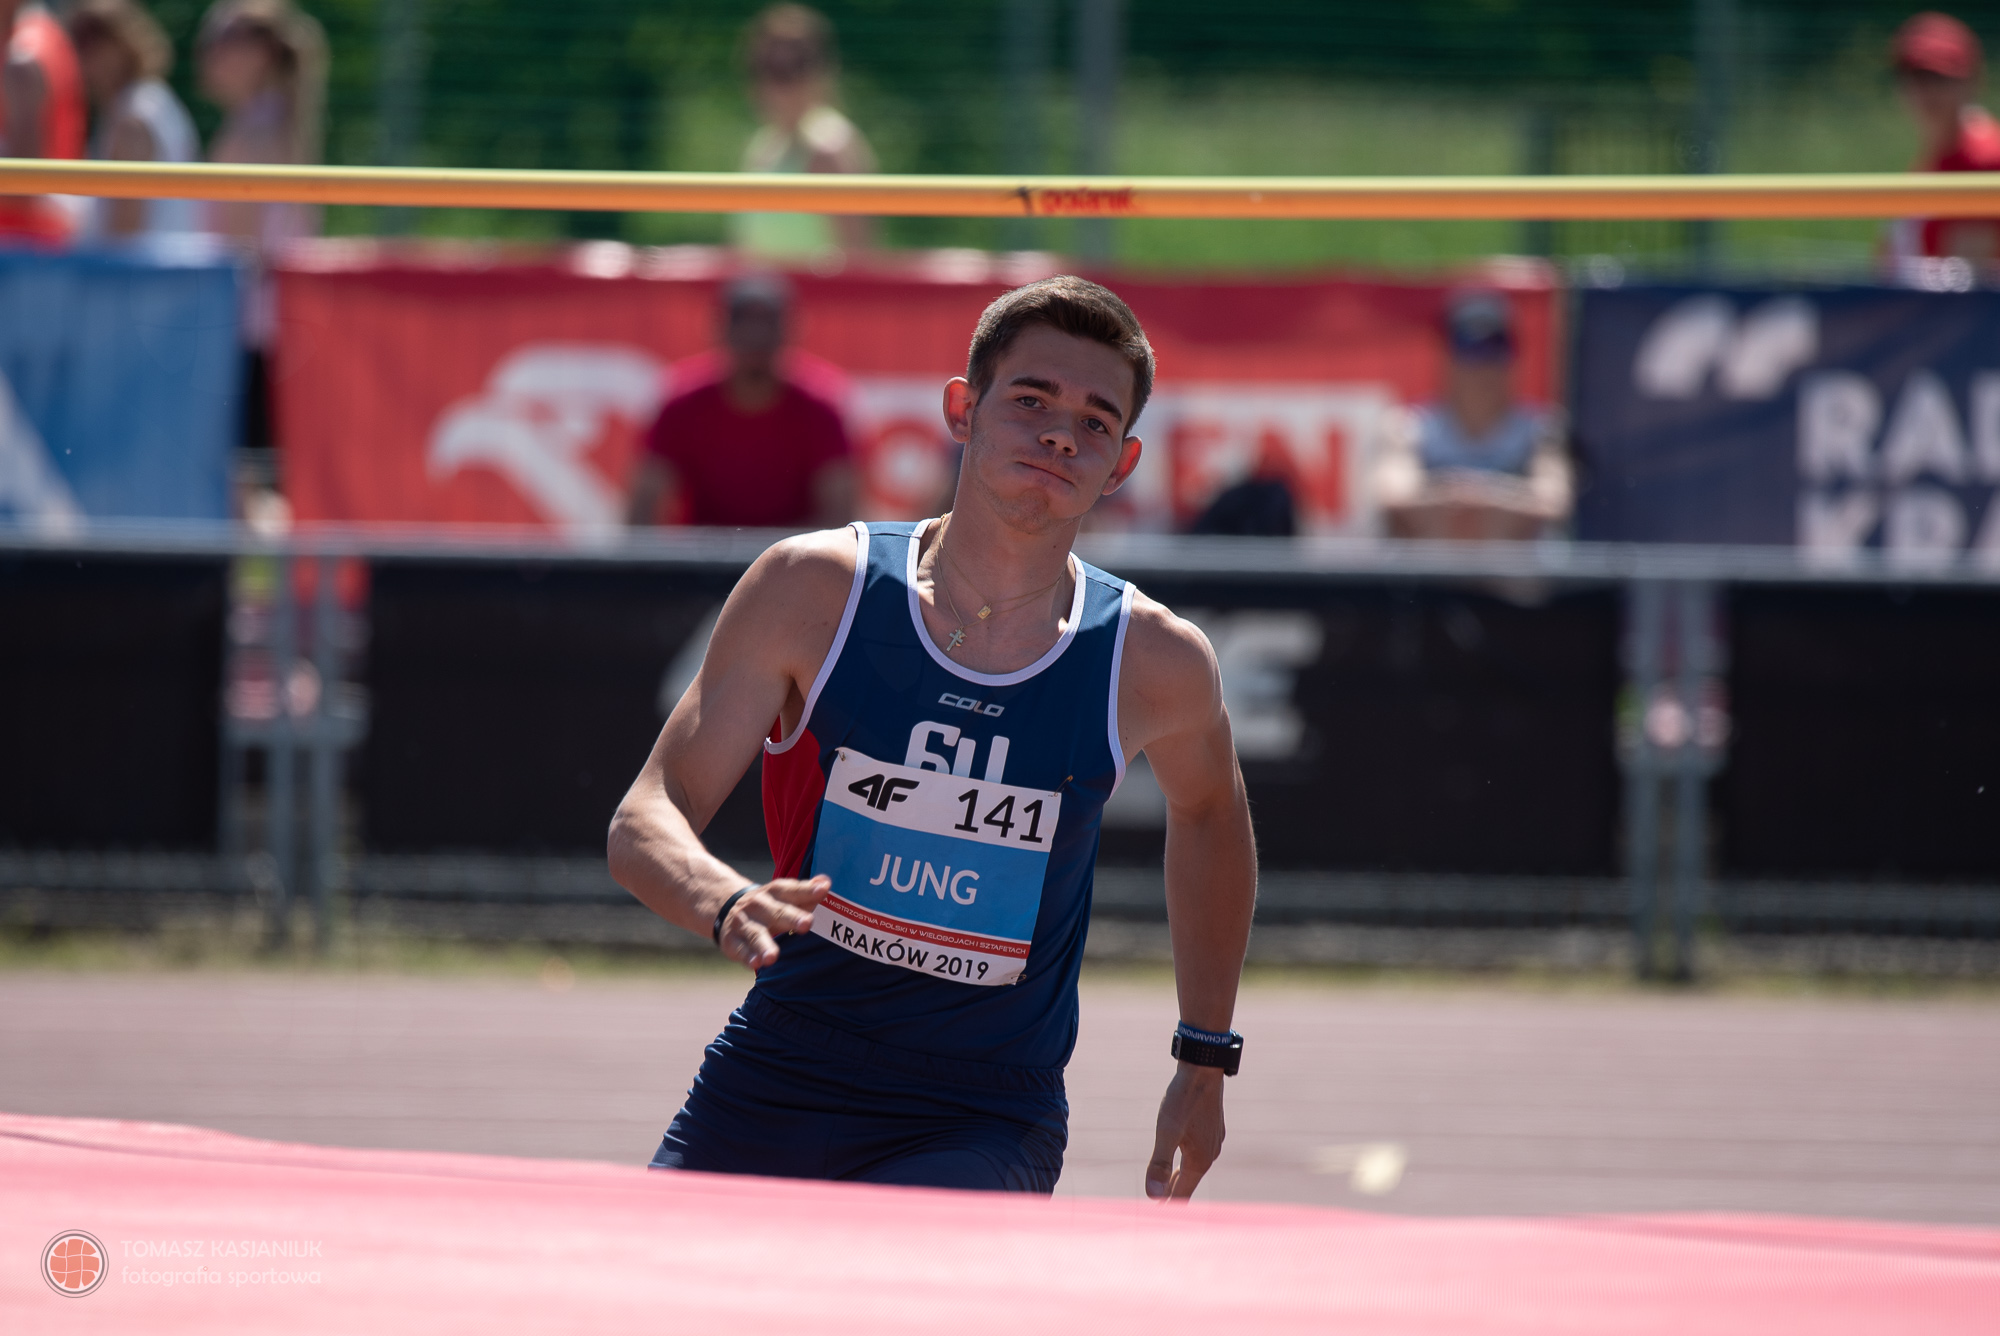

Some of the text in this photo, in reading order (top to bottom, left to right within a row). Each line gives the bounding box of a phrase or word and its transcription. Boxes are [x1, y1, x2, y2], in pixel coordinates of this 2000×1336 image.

[938, 692, 1005, 718] COLO
[847, 773, 920, 812] 4F
[954, 788, 1044, 843] 141
[869, 853, 980, 905] JUNG
[828, 900, 879, 926] MISTRZOSTWA
[879, 920, 908, 933] POLSKI
[919, 930, 975, 947] WIELOBOJACH
[979, 942, 1026, 955] SZTAFETACH
[830, 919, 989, 980] KRAKÓW 2019
